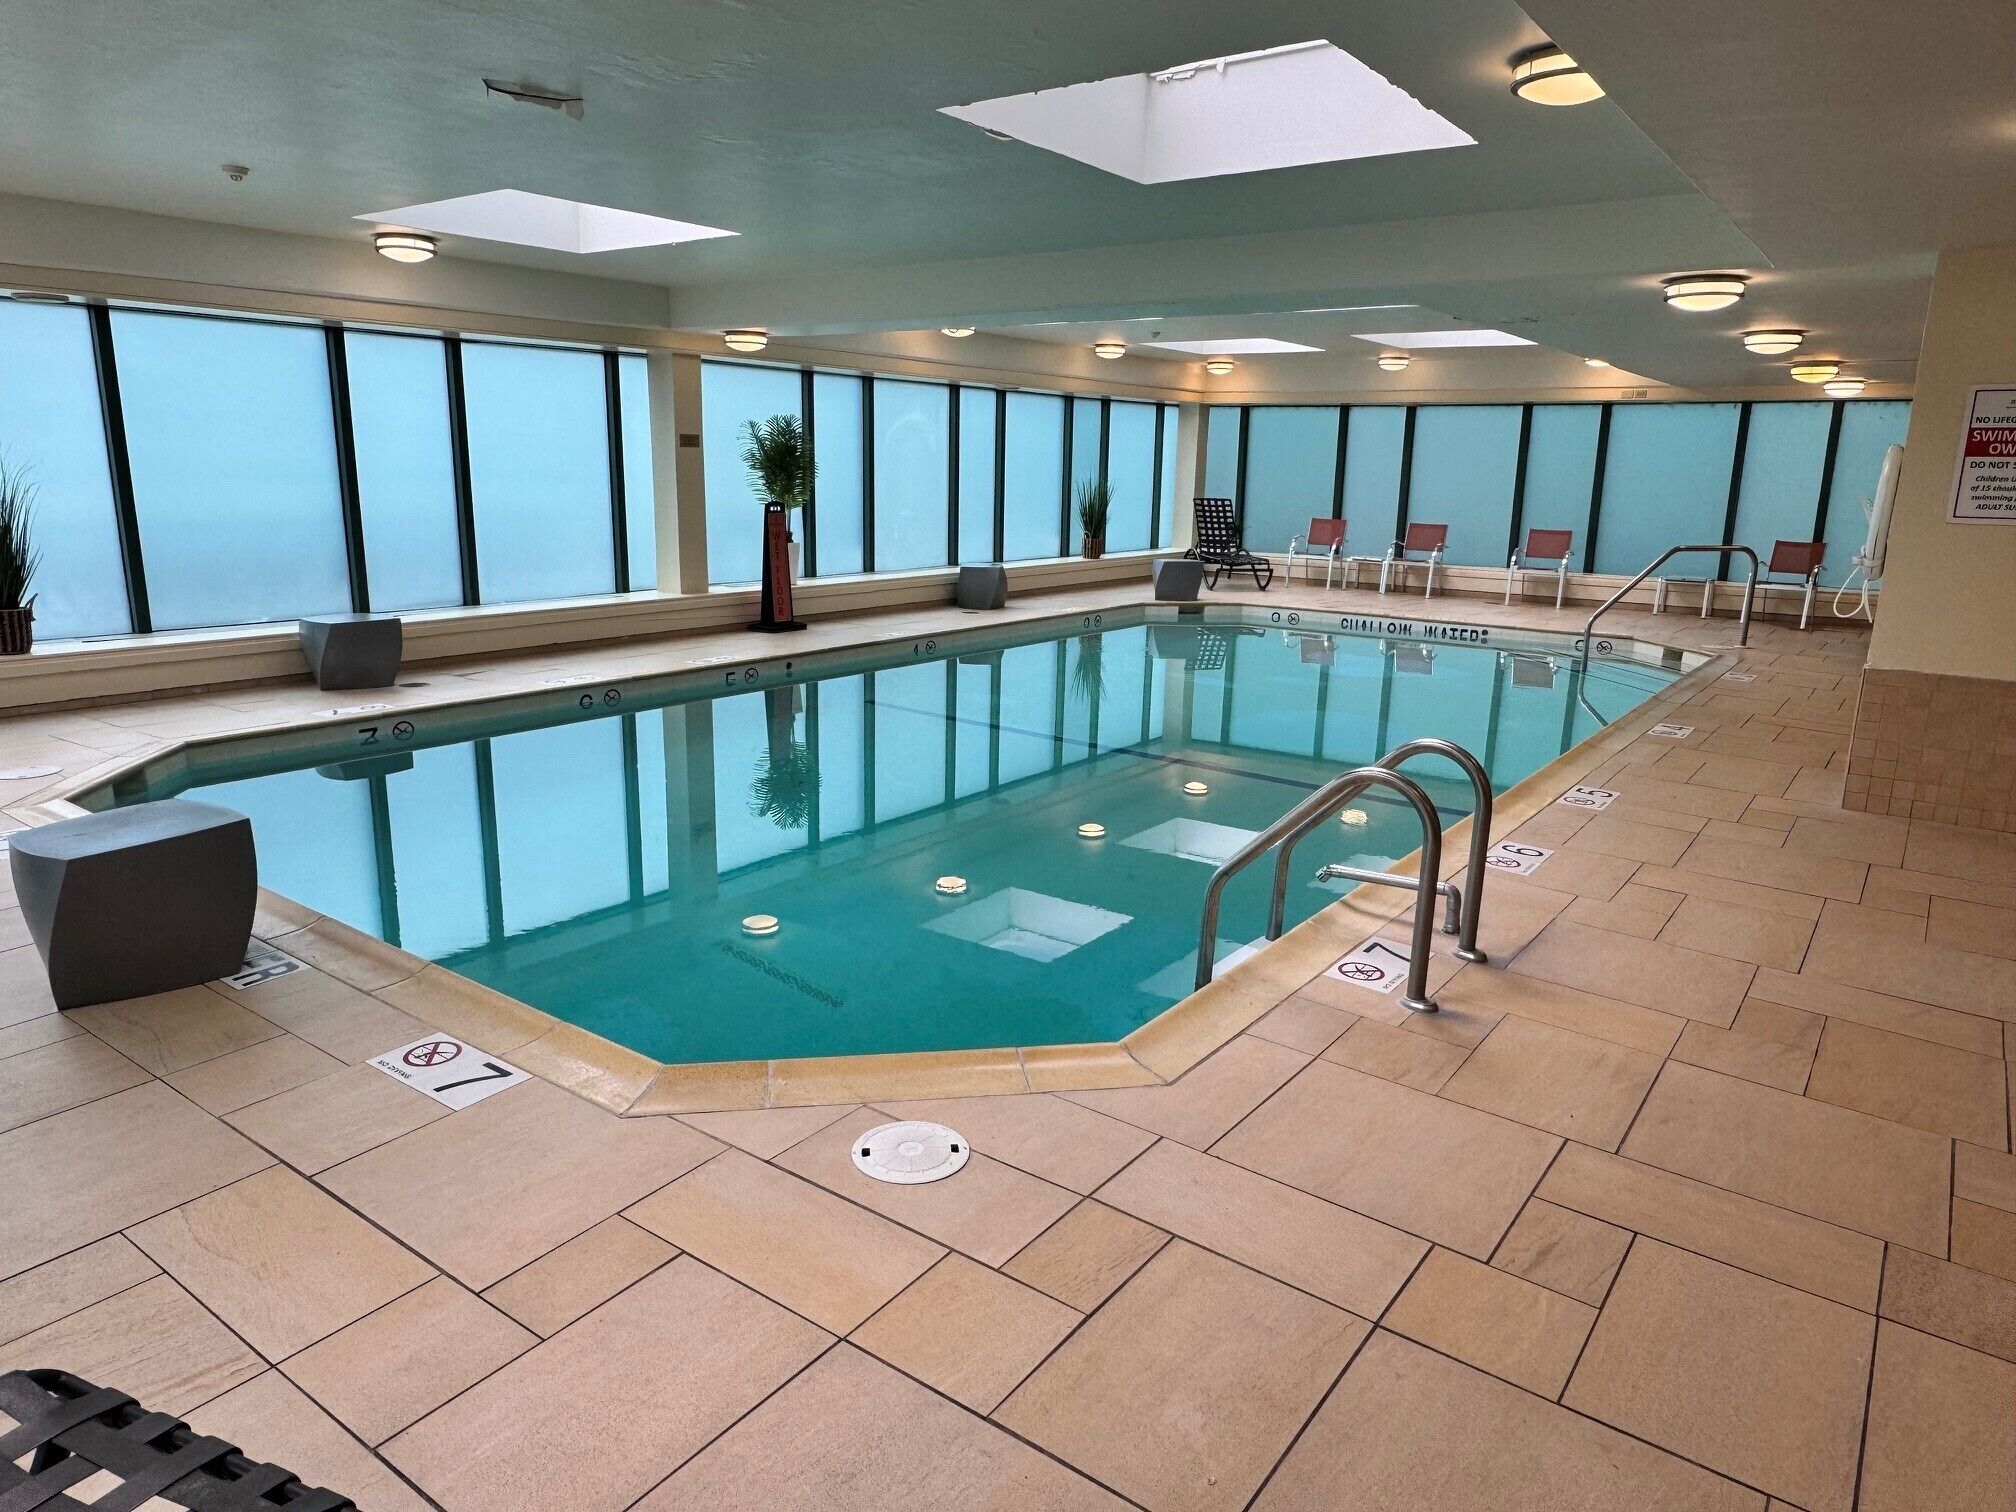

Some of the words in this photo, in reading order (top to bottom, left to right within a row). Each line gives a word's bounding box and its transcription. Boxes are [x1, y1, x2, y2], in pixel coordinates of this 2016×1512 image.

[1975, 416, 1991, 424] NO
[1972, 429, 2016, 442] SWIM
[1970, 461, 1986, 469] DO
[1988, 461, 2011, 469] NOT
[1975, 475, 2009, 483] Children
[1970, 484, 1980, 492] of
[1980, 484, 1991, 492] 15
[1970, 494, 2013, 503] swimming
[1975, 503, 2003, 511] ADULT
[1575, 787, 1614, 798] 5
[1501, 844, 1544, 857] 6
[432, 1061, 514, 1093] 7
